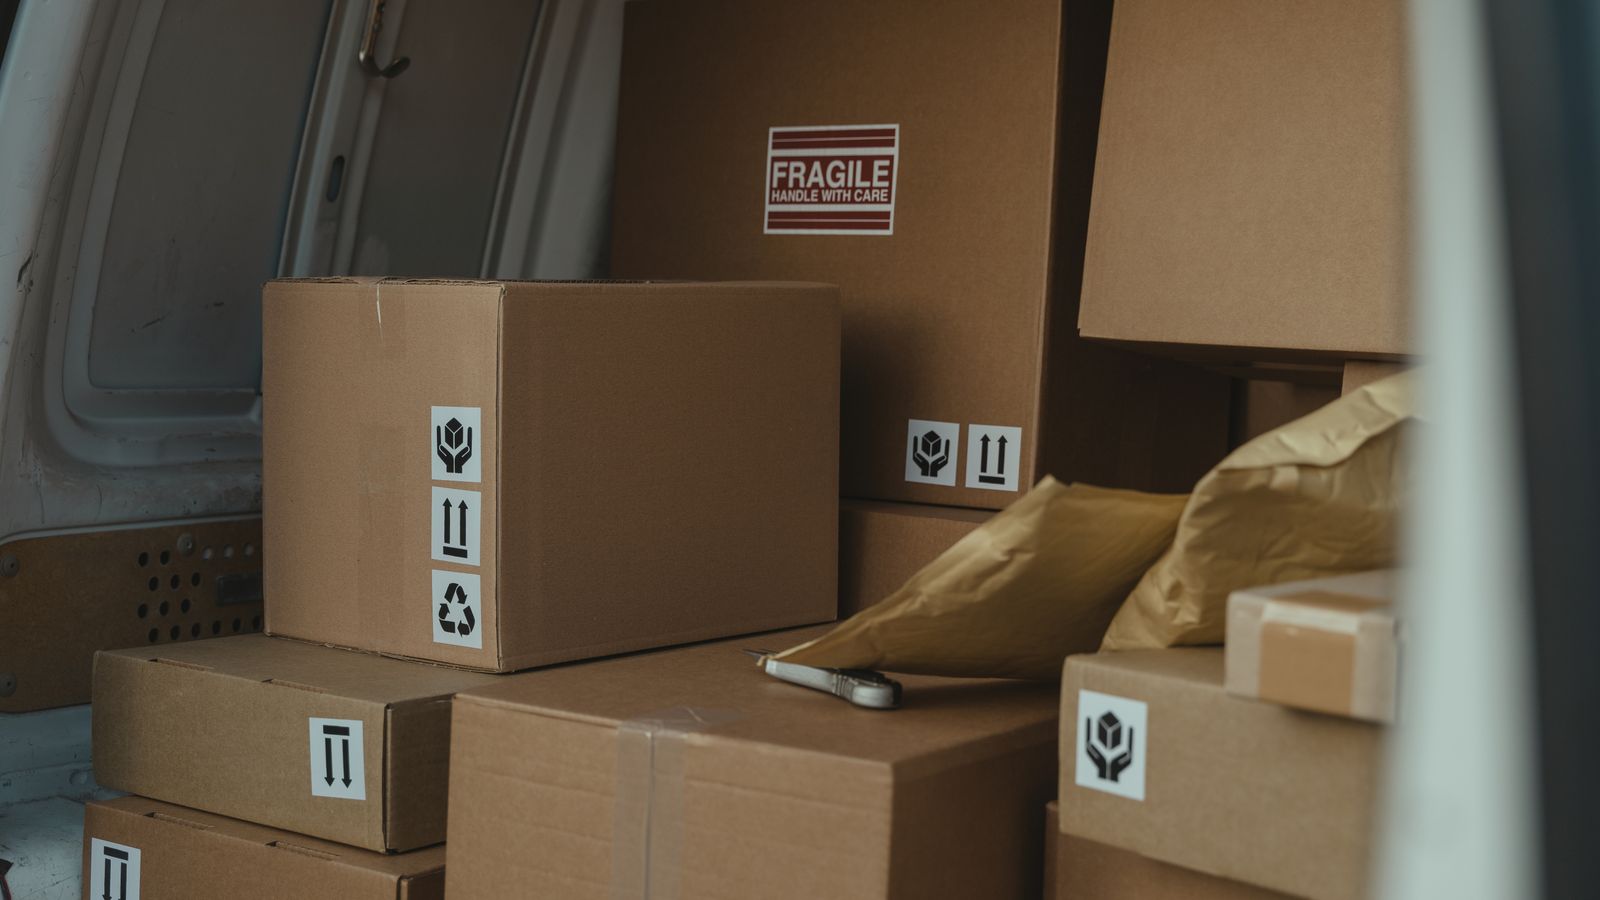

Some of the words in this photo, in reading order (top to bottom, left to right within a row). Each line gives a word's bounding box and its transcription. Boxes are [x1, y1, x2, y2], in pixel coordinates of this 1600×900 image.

[772, 160, 890, 188] FRAGILE
[771, 189, 818, 202] HANDLE
[821, 189, 851, 202] WITH
[853, 189, 889, 202] CARE
